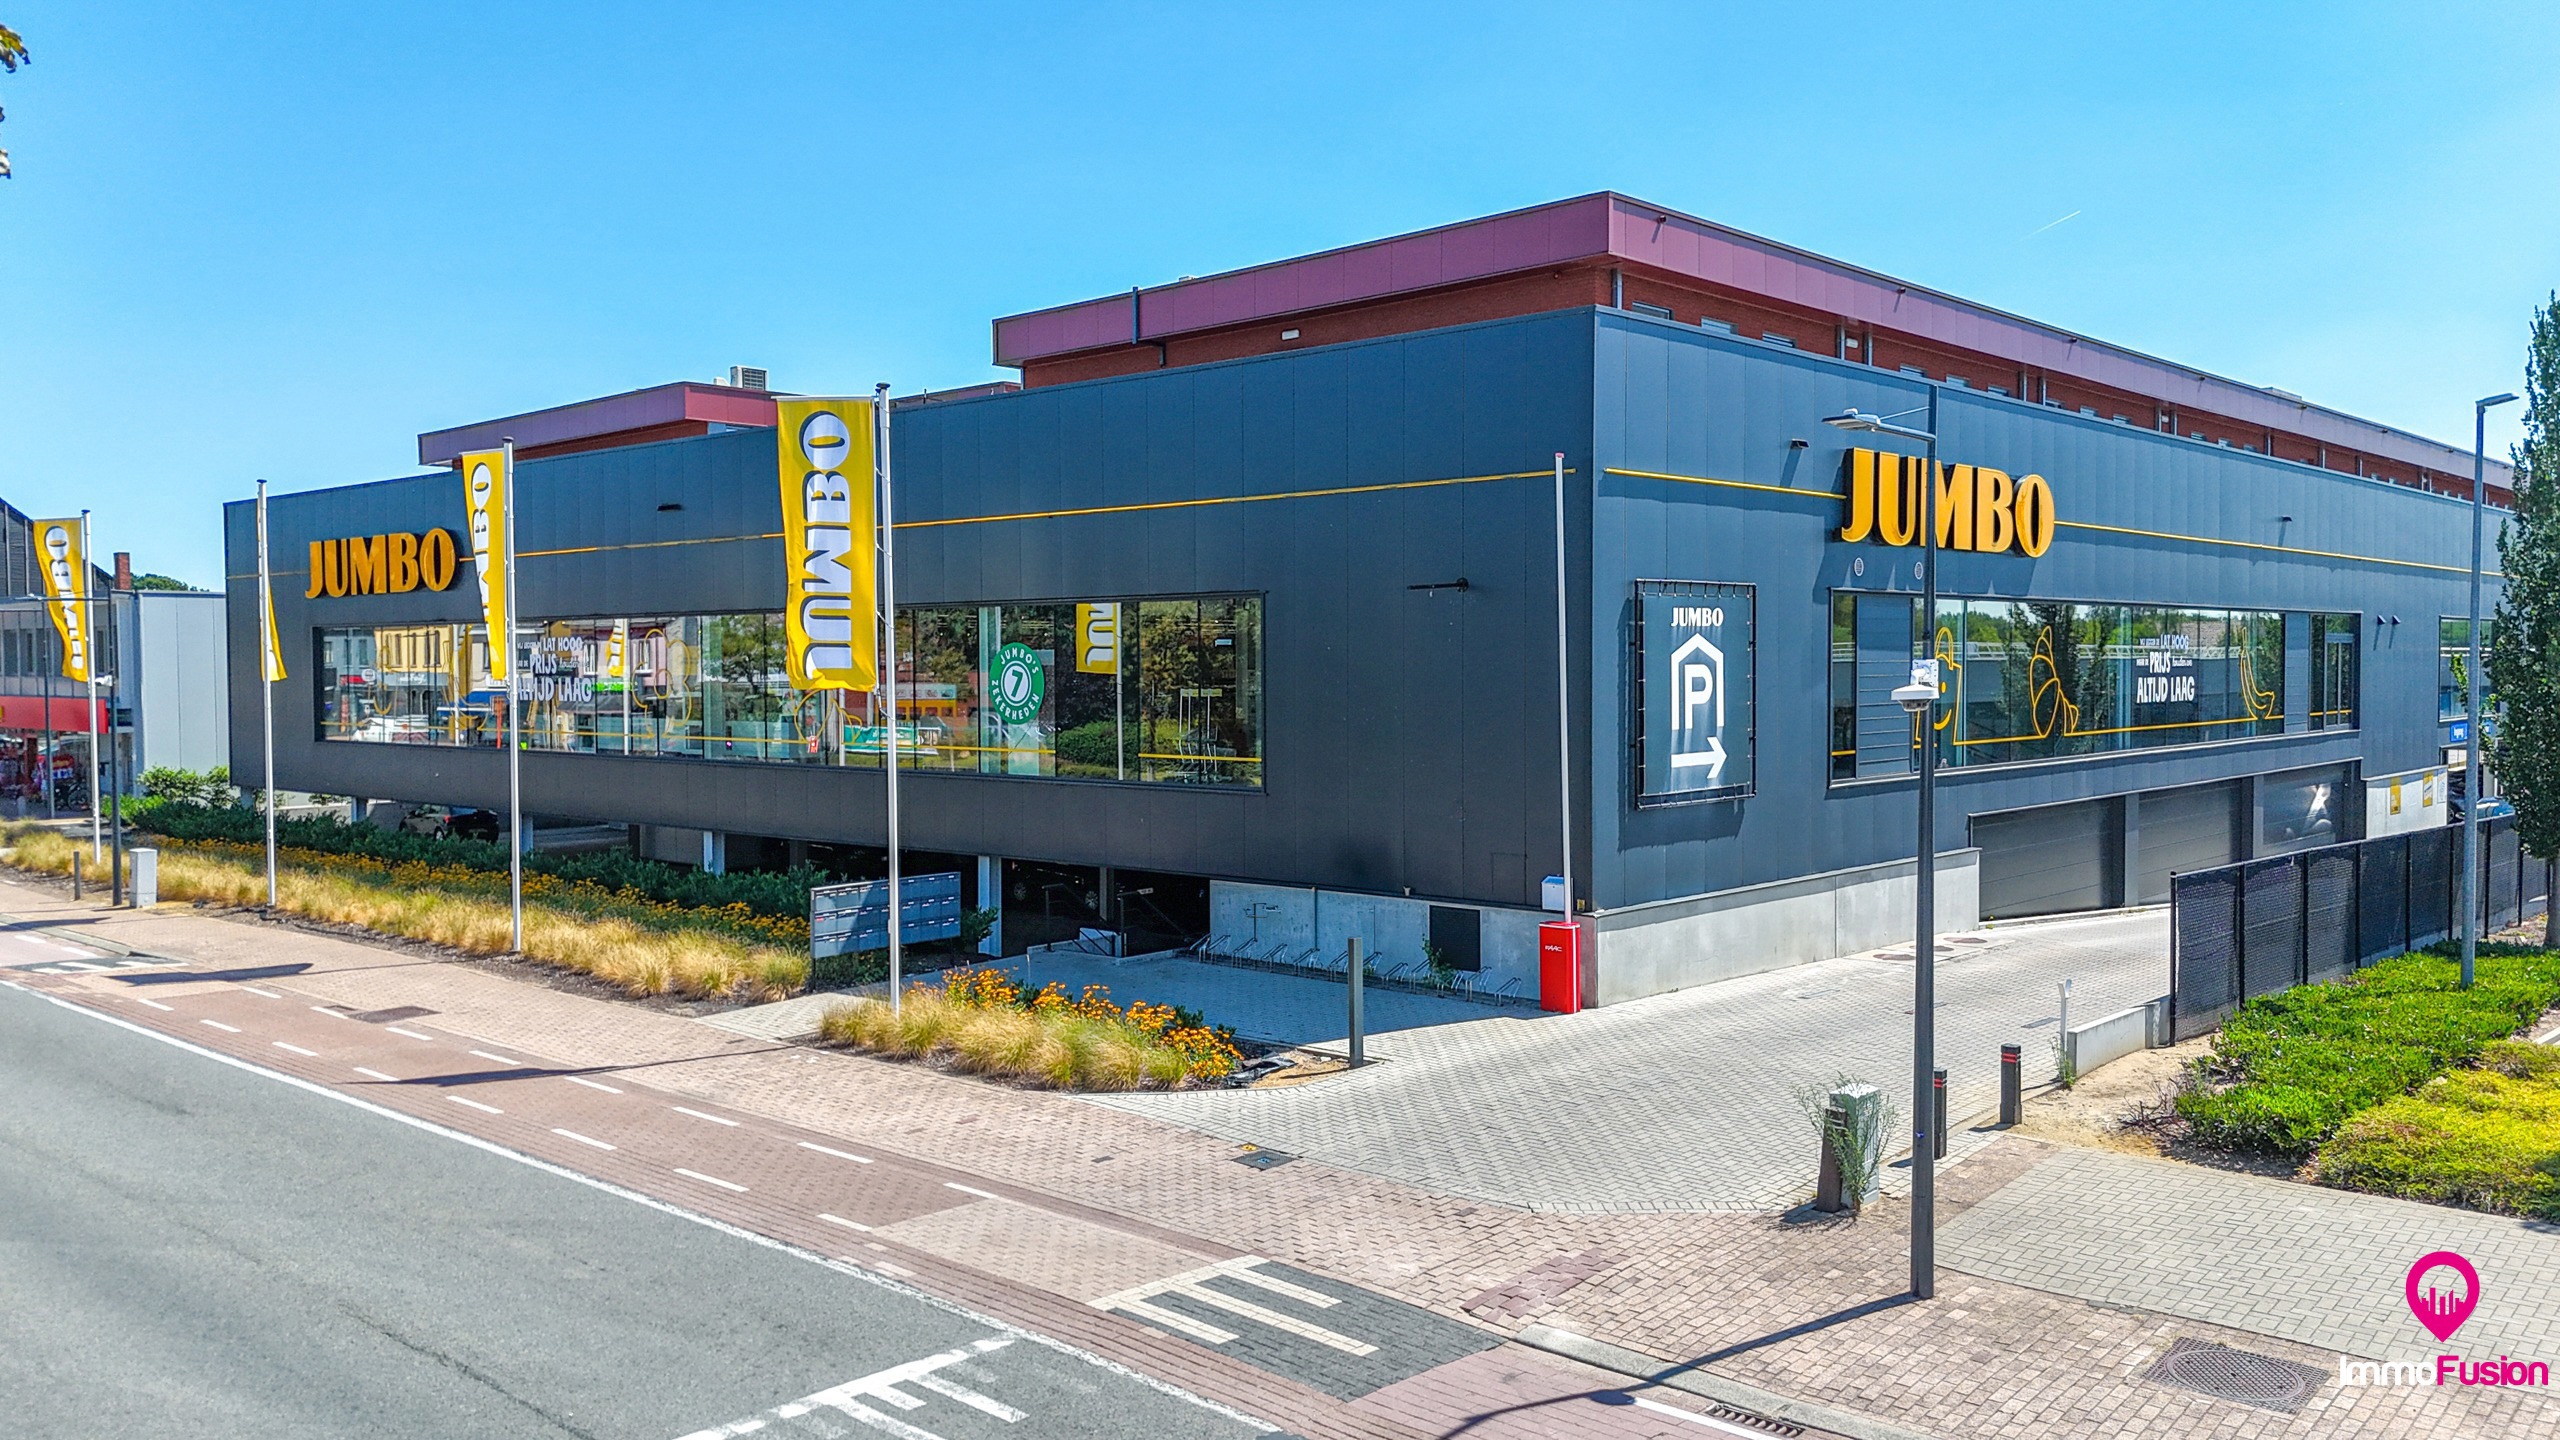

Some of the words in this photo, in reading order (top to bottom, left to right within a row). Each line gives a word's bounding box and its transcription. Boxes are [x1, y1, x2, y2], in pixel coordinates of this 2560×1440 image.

[1841, 447, 2055, 558] JUMBO
[305, 528, 456, 599] JUMBO
[1670, 607, 1724, 627] JUMBO
[543, 637, 556, 651] LAT
[529, 653, 557, 674] PRIJS
[1000, 647, 1040, 674] JUMBO'S
[2150, 651, 2171, 673] PRIJS
[558, 677, 592, 703] LAAG
[1011, 669, 1024, 698] 7
[1684, 663, 1714, 729] P
[2136, 677, 2168, 704] ALTIJD
[2170, 676, 2195, 702] LAAG
